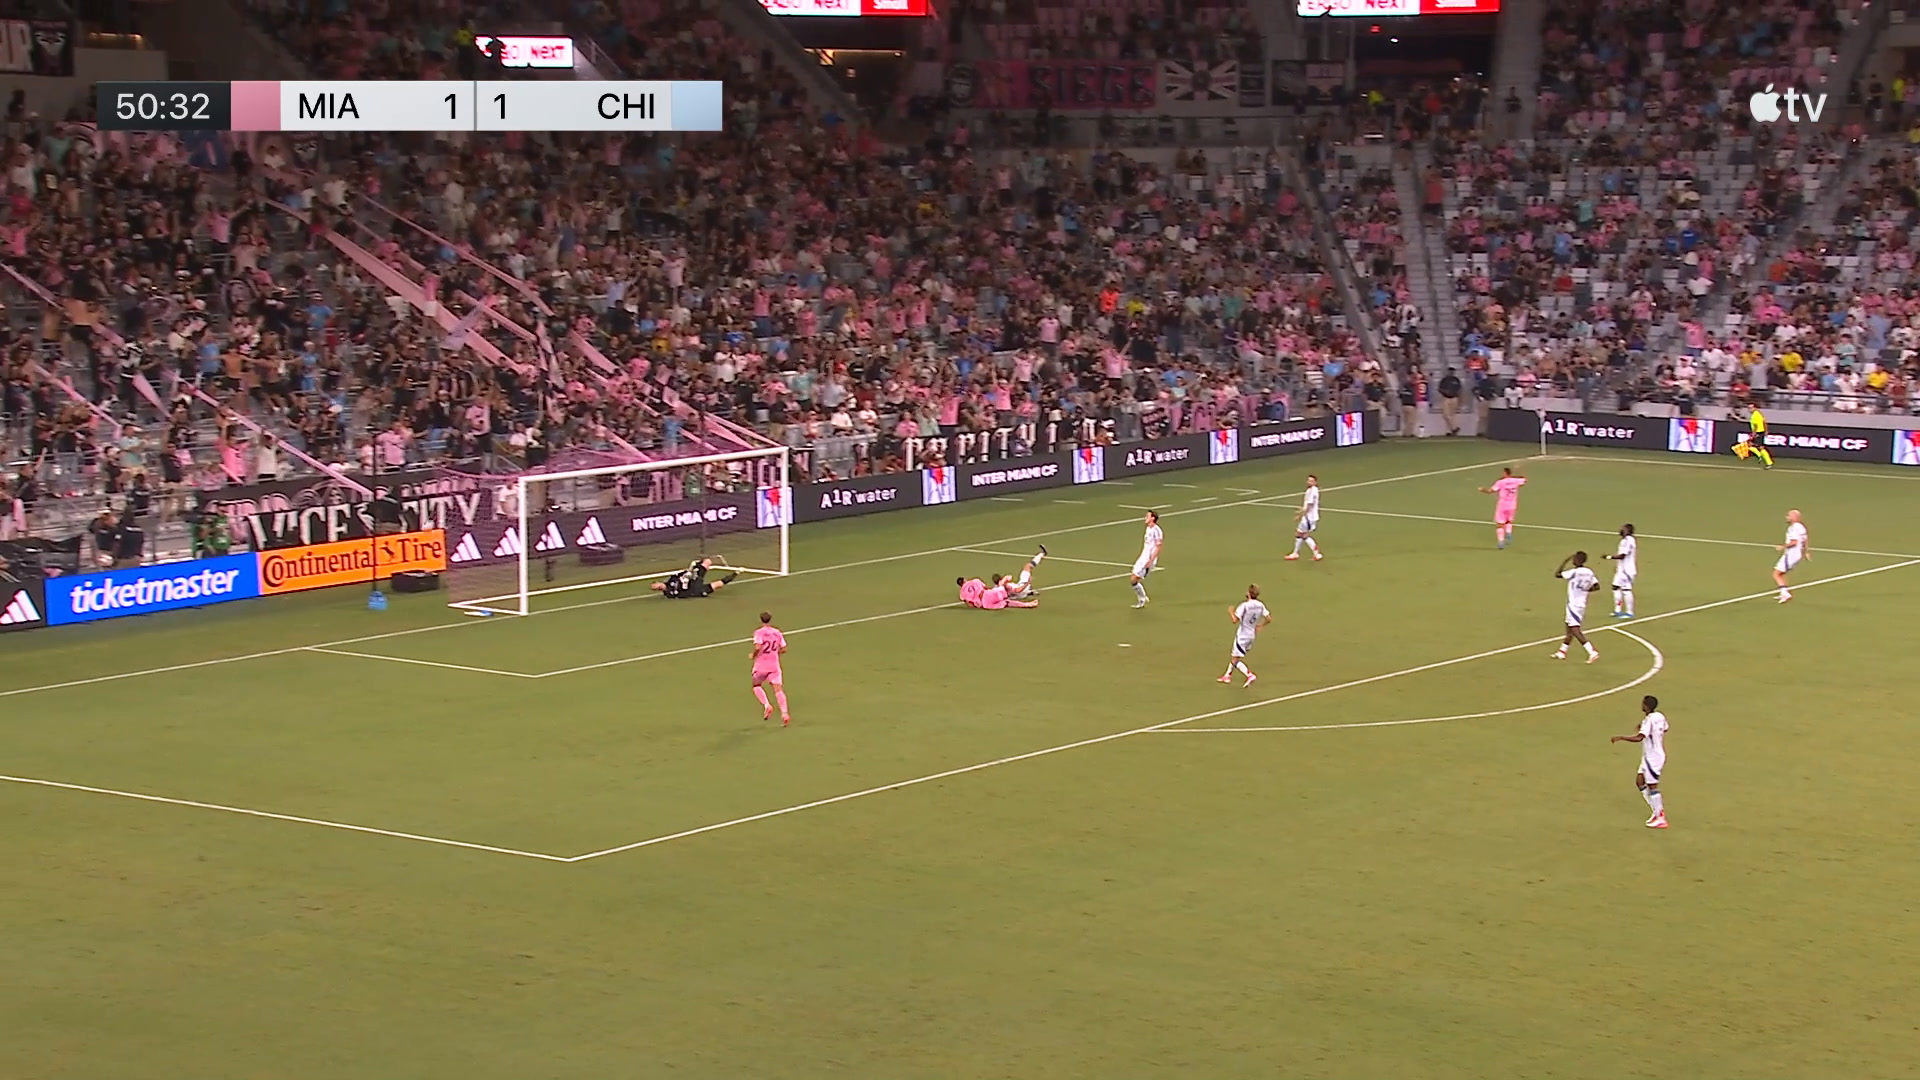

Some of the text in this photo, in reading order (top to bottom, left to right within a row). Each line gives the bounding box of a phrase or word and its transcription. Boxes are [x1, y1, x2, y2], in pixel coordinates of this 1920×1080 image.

[1029, 64, 1155, 105] SIEGE
[1250, 428, 1325, 448] INTER MIAMI CF
[1582, 426, 1635, 439] water
[1737, 433, 1868, 451] INER MIAMI CF
[1154, 449, 1189, 462] water
[971, 464, 1058, 486] INTER MIAMI CF
[855, 488, 897, 503] water
[632, 513, 675, 531] INTER
[717, 507, 738, 520] CF
[263, 537, 442, 588] Continental Tire
[70, 568, 240, 614] ticketmaster
